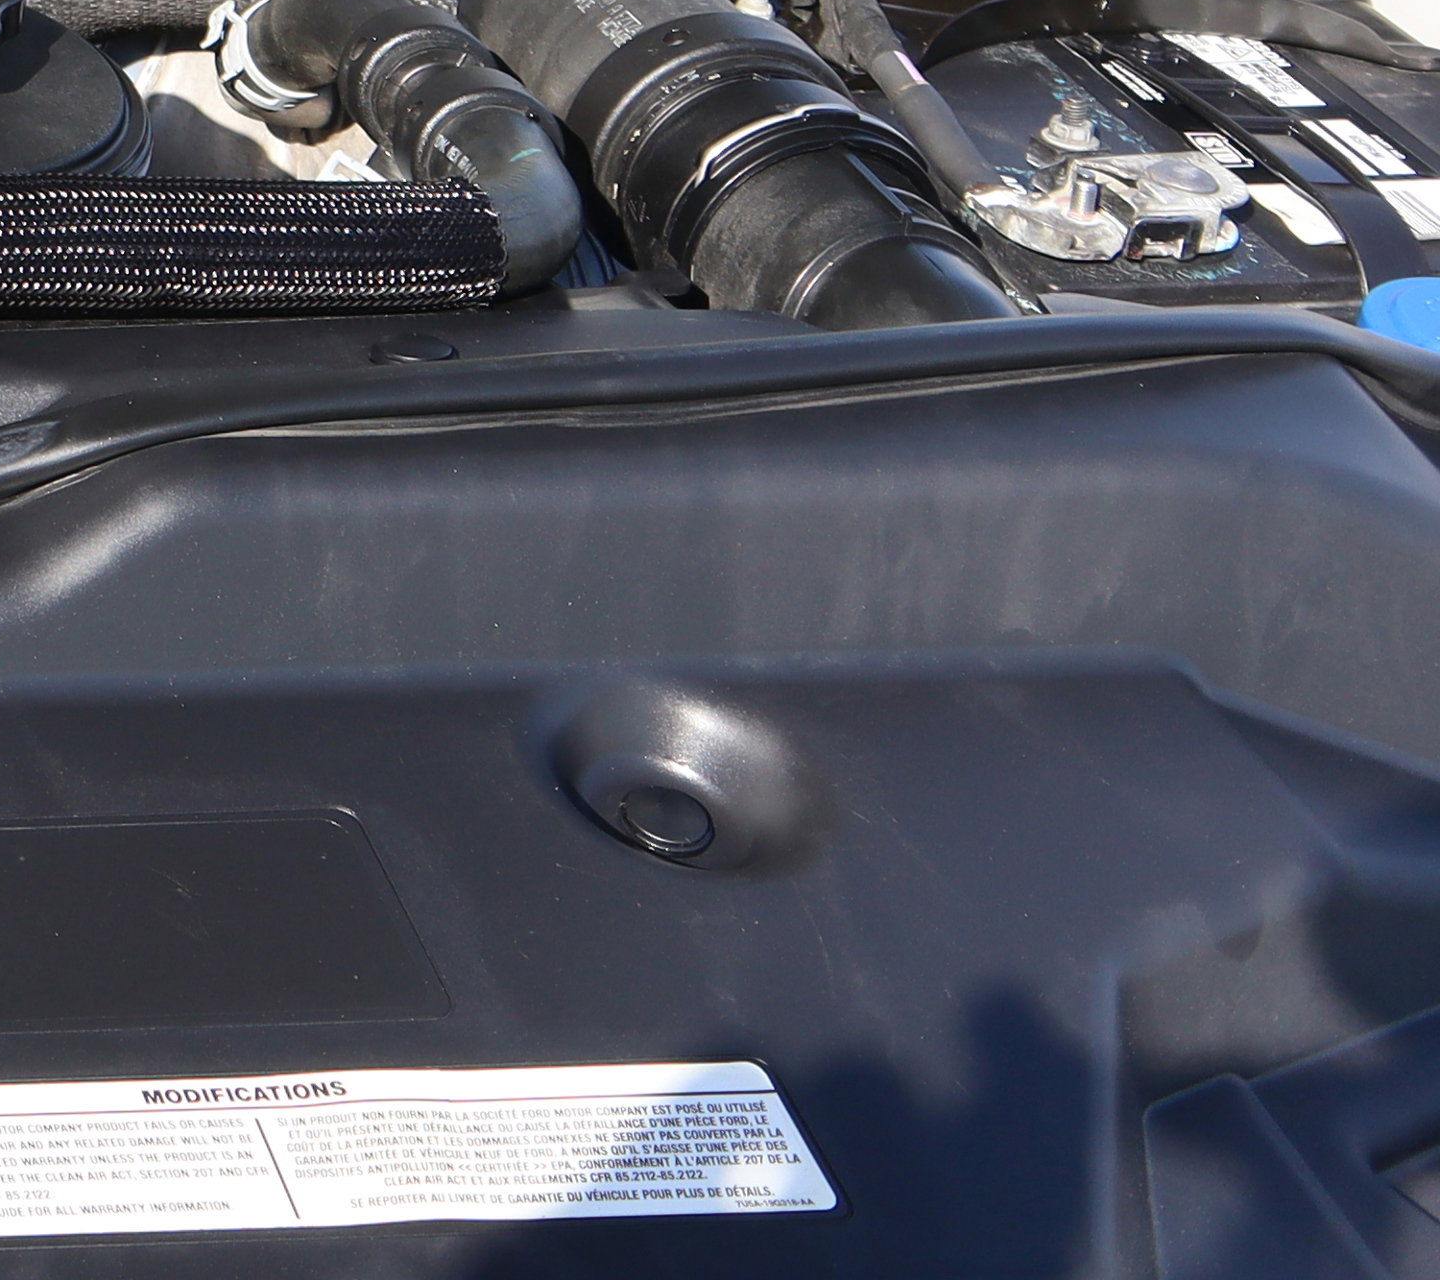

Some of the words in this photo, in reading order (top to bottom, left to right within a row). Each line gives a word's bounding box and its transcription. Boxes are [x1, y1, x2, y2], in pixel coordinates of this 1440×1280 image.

[140, 1080, 348, 1106] MODIFICATIONS
[276, 1117, 288, 1127] SI
[291, 1117, 307, 1126] UN
[309, 1112, 357, 1125] PRODUIT
[361, 1111, 385, 1120] NON
[388, 1110, 428, 1119] FOURNI
[431, 1110, 452, 1120] PAR
[454, 1111, 470, 1122] LA
[472, 1109, 518, 1121] SOCIÉTÉ
[521, 1108, 551, 1119] FORD
[553, 1107, 592, 1117] MOTOR
[596, 1105, 648, 1116] COMPANY
[651, 1104, 672, 1115] EST
[674, 1103, 705, 1115] POSÉ
[706, 1103, 723, 1114] OU
[724, 1102, 767, 1113] UTILISÉ
[27, 1123, 82, 1133] COMPANY
[86, 1121, 139, 1132] PRODUCT
[143, 1120, 177, 1130] FAILS
[178, 1119, 196, 1129] OR
[198, 1118, 244, 1128] CAUSES
[20, 1140, 44, 1150] AND
[48, 1140, 69, 1149] ANY
[73, 1138, 126, 1148] RELATED
[128, 1136, 175, 1147] DAMAGE
[179, 1136, 207, 1145] WILL
[211, 1134, 234, 1144] NOT
[238, 1133, 253, 1144] BE
[20, 1155, 85, 1166] WARRANTY
[89, 1153, 135, 1164] UNLESS
[137, 1153, 159, 1162] THE
[163, 1151, 217, 1162] PRODUCT
[220, 1150, 234, 1161] IS
[237, 1150, 254, 1160] AN
[19, 1173, 40, 1183] THE
[44, 1172, 84, 1182] CLEAN
[87, 1171, 107, 1181] AIR
[139, 1168, 190, 1179] SECTION
[192, 1167, 213, 1178] 207
[218, 1167, 243, 1177] AND
[245, 1166, 269, 1176] CFR
[384, 1175, 421, 1186] CLEAN
[424, 1175, 443, 1184] AIR
[446, 1175, 466, 1185] ACT
[470, 1175, 483, 1186] ET
[488, 1176, 510, 1186] AUX
[589, 1172, 613, 1183] CFR
[614, 1169, 707, 1182] 85.2112-85.2122.
[350, 1197, 364, 1209] SE
[368, 1194, 427, 1206] REPORTER
[430, 1193, 445, 1203] AU
[448, 1193, 485, 1204] LIVRET
[489, 1194, 504, 1204] DE
[508, 1192, 564, 1203] GARANTIE
[566, 1191, 583, 1202] DU
[584, 1189, 640, 1201] VÉHICULE
[641, 1188, 674, 1200] POUR
[675, 1187, 705, 1199] PLUS
[706, 1187, 723, 1198] DE
[724, 1186, 775, 1197] DÉTAILS.
[27, 1206, 52, 1216] FOR
[55, 1205, 77, 1216] ALL
[79, 1203, 145, 1214] WARRANTY
